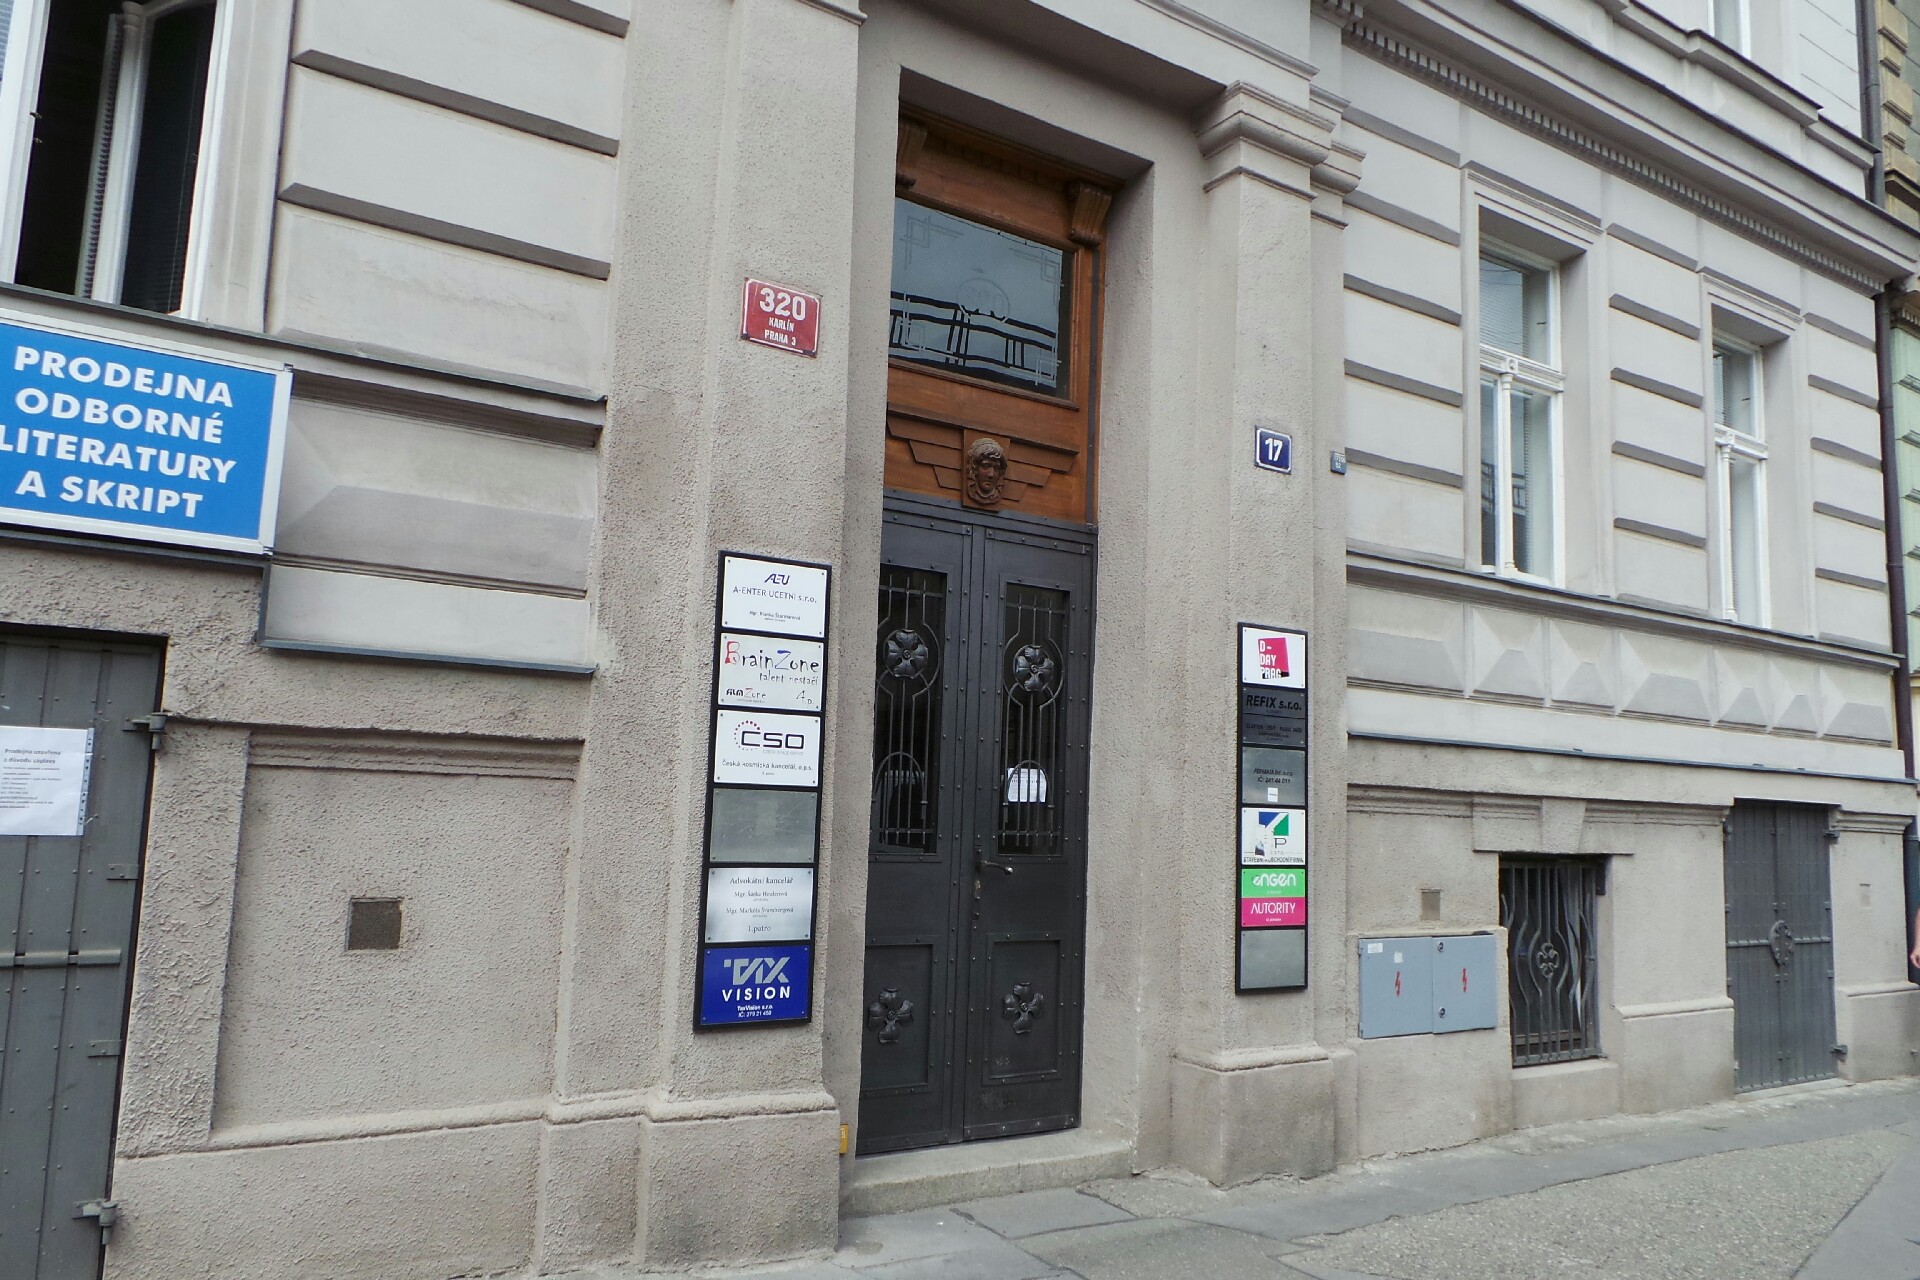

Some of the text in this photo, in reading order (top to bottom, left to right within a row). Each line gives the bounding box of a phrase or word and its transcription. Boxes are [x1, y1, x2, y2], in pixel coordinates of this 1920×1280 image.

[760, 287, 806, 320] 320
[768, 317, 795, 332] KARLÍN
[764, 329, 796, 346] PRAHA 3
[14, 346, 233, 408] PRODEJNA
[15, 387, 224, 444] ODBORNÉ
[0, 424, 237, 483] LITERATURY
[1264, 437, 1283, 462] 17
[15, 470, 204, 518] A SKRIPT
[733, 586, 766, 597] A-ENTER
[1260, 653, 1277, 666] DAY
[760, 670, 784, 683] talent
[1246, 694, 1302, 711] REFIX s.r.o.
[741, 731, 804, 749] CSO
[722, 759, 740, 767] Česká
[730, 876, 794, 885] Advokátní kancelář
[1250, 902, 1296, 915] AUTORITY
[724, 957, 790, 985] TAX
[722, 986, 790, 1002] VISION
